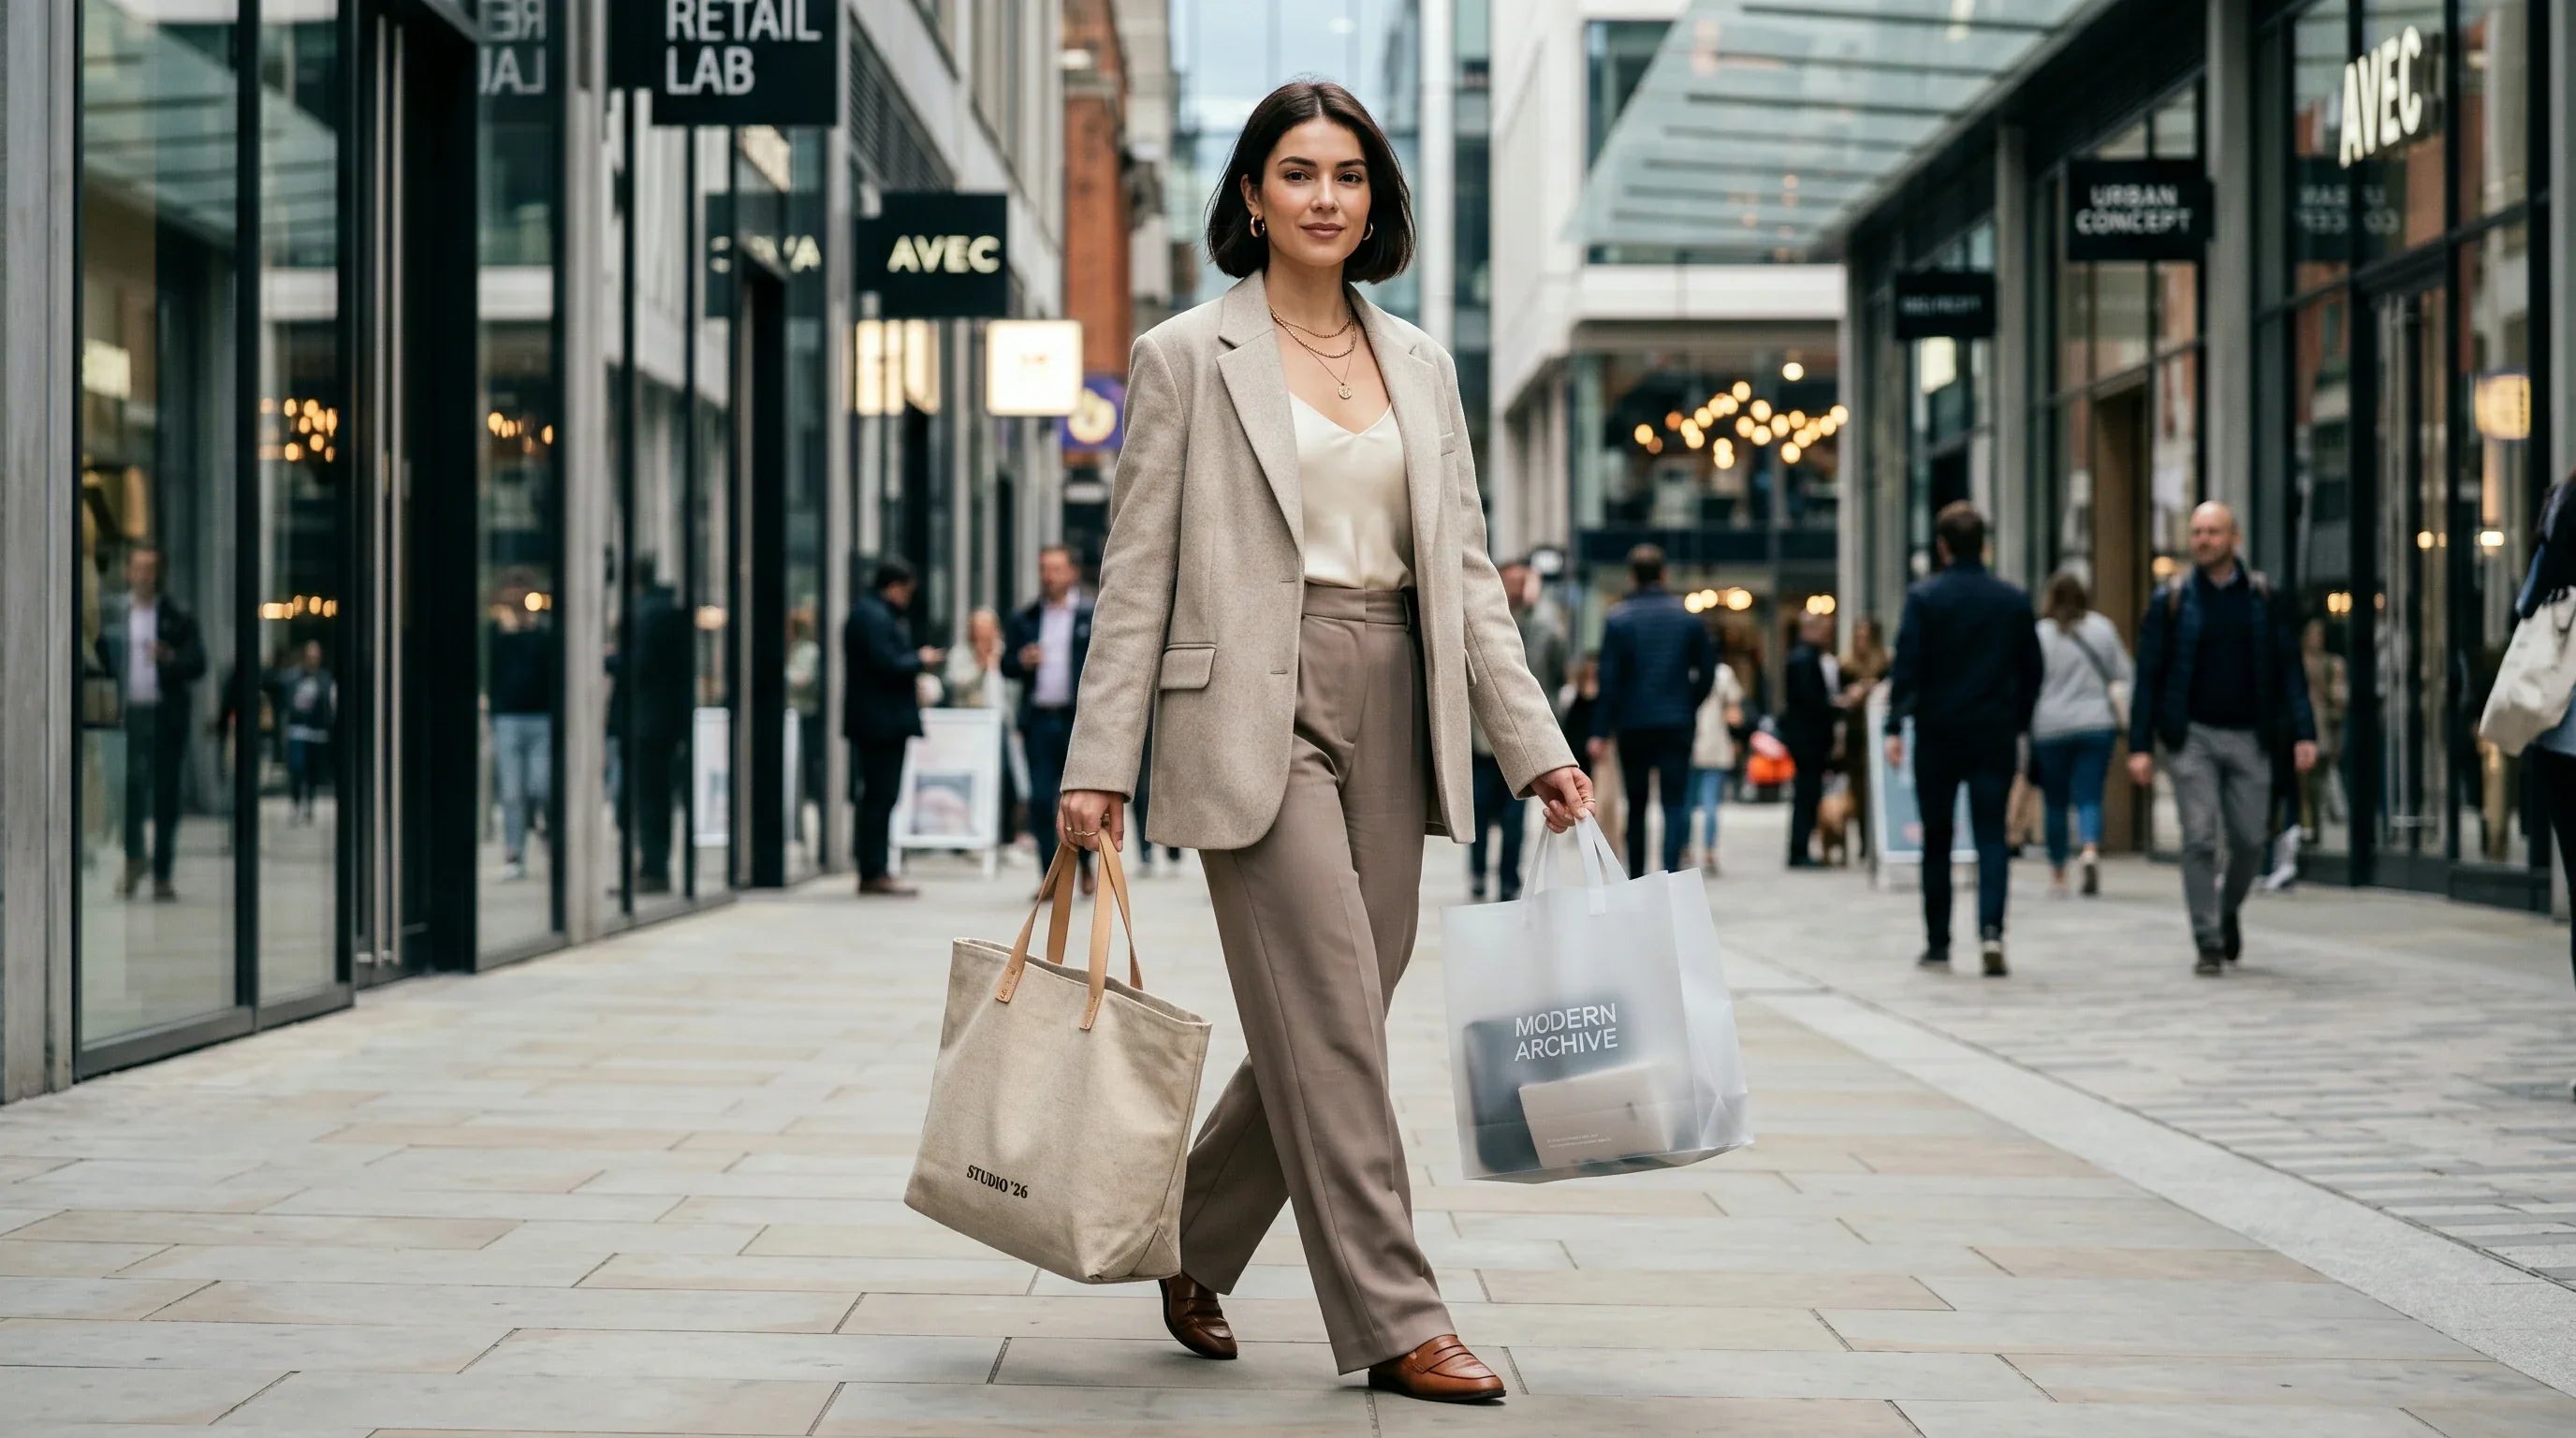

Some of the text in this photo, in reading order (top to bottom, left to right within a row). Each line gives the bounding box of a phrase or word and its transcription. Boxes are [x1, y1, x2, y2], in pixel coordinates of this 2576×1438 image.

[666, 0, 824, 41] RETAIL
[666, 46, 755, 95] LAB
[2339, 25, 2422, 169] AVEC
[2089, 184, 2178, 207] URBAN
[2075, 208, 2193, 234] CONCEPT
[886, 235, 1001, 273] AVEC
[1515, 1003, 1617, 1037] MODERN
[1514, 1028, 1618, 1062] ARCHIVE
[967, 1165, 1028, 1198] STUDIO '26
